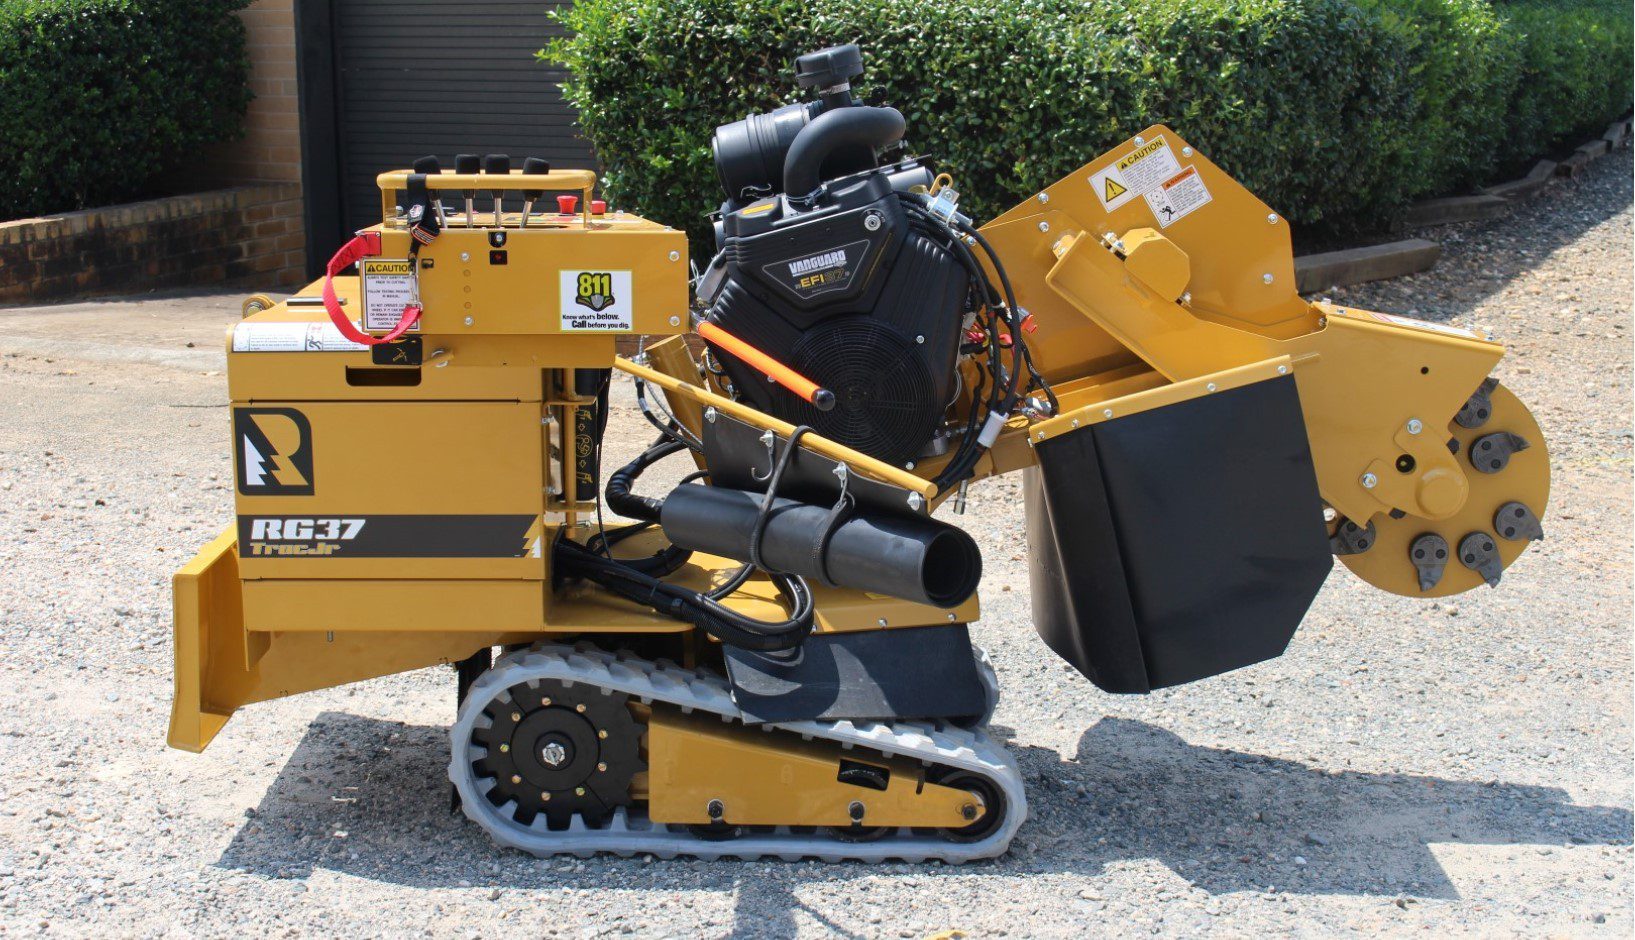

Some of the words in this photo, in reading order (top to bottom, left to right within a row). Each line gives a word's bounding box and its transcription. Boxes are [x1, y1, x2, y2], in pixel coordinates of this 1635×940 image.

[1127, 140, 1163, 164] CAUTION
[788, 250, 846, 274] VANGUARD
[579, 274, 610, 297] 811
[572, 320, 587, 328] Call
[251, 518, 366, 540] RG37
